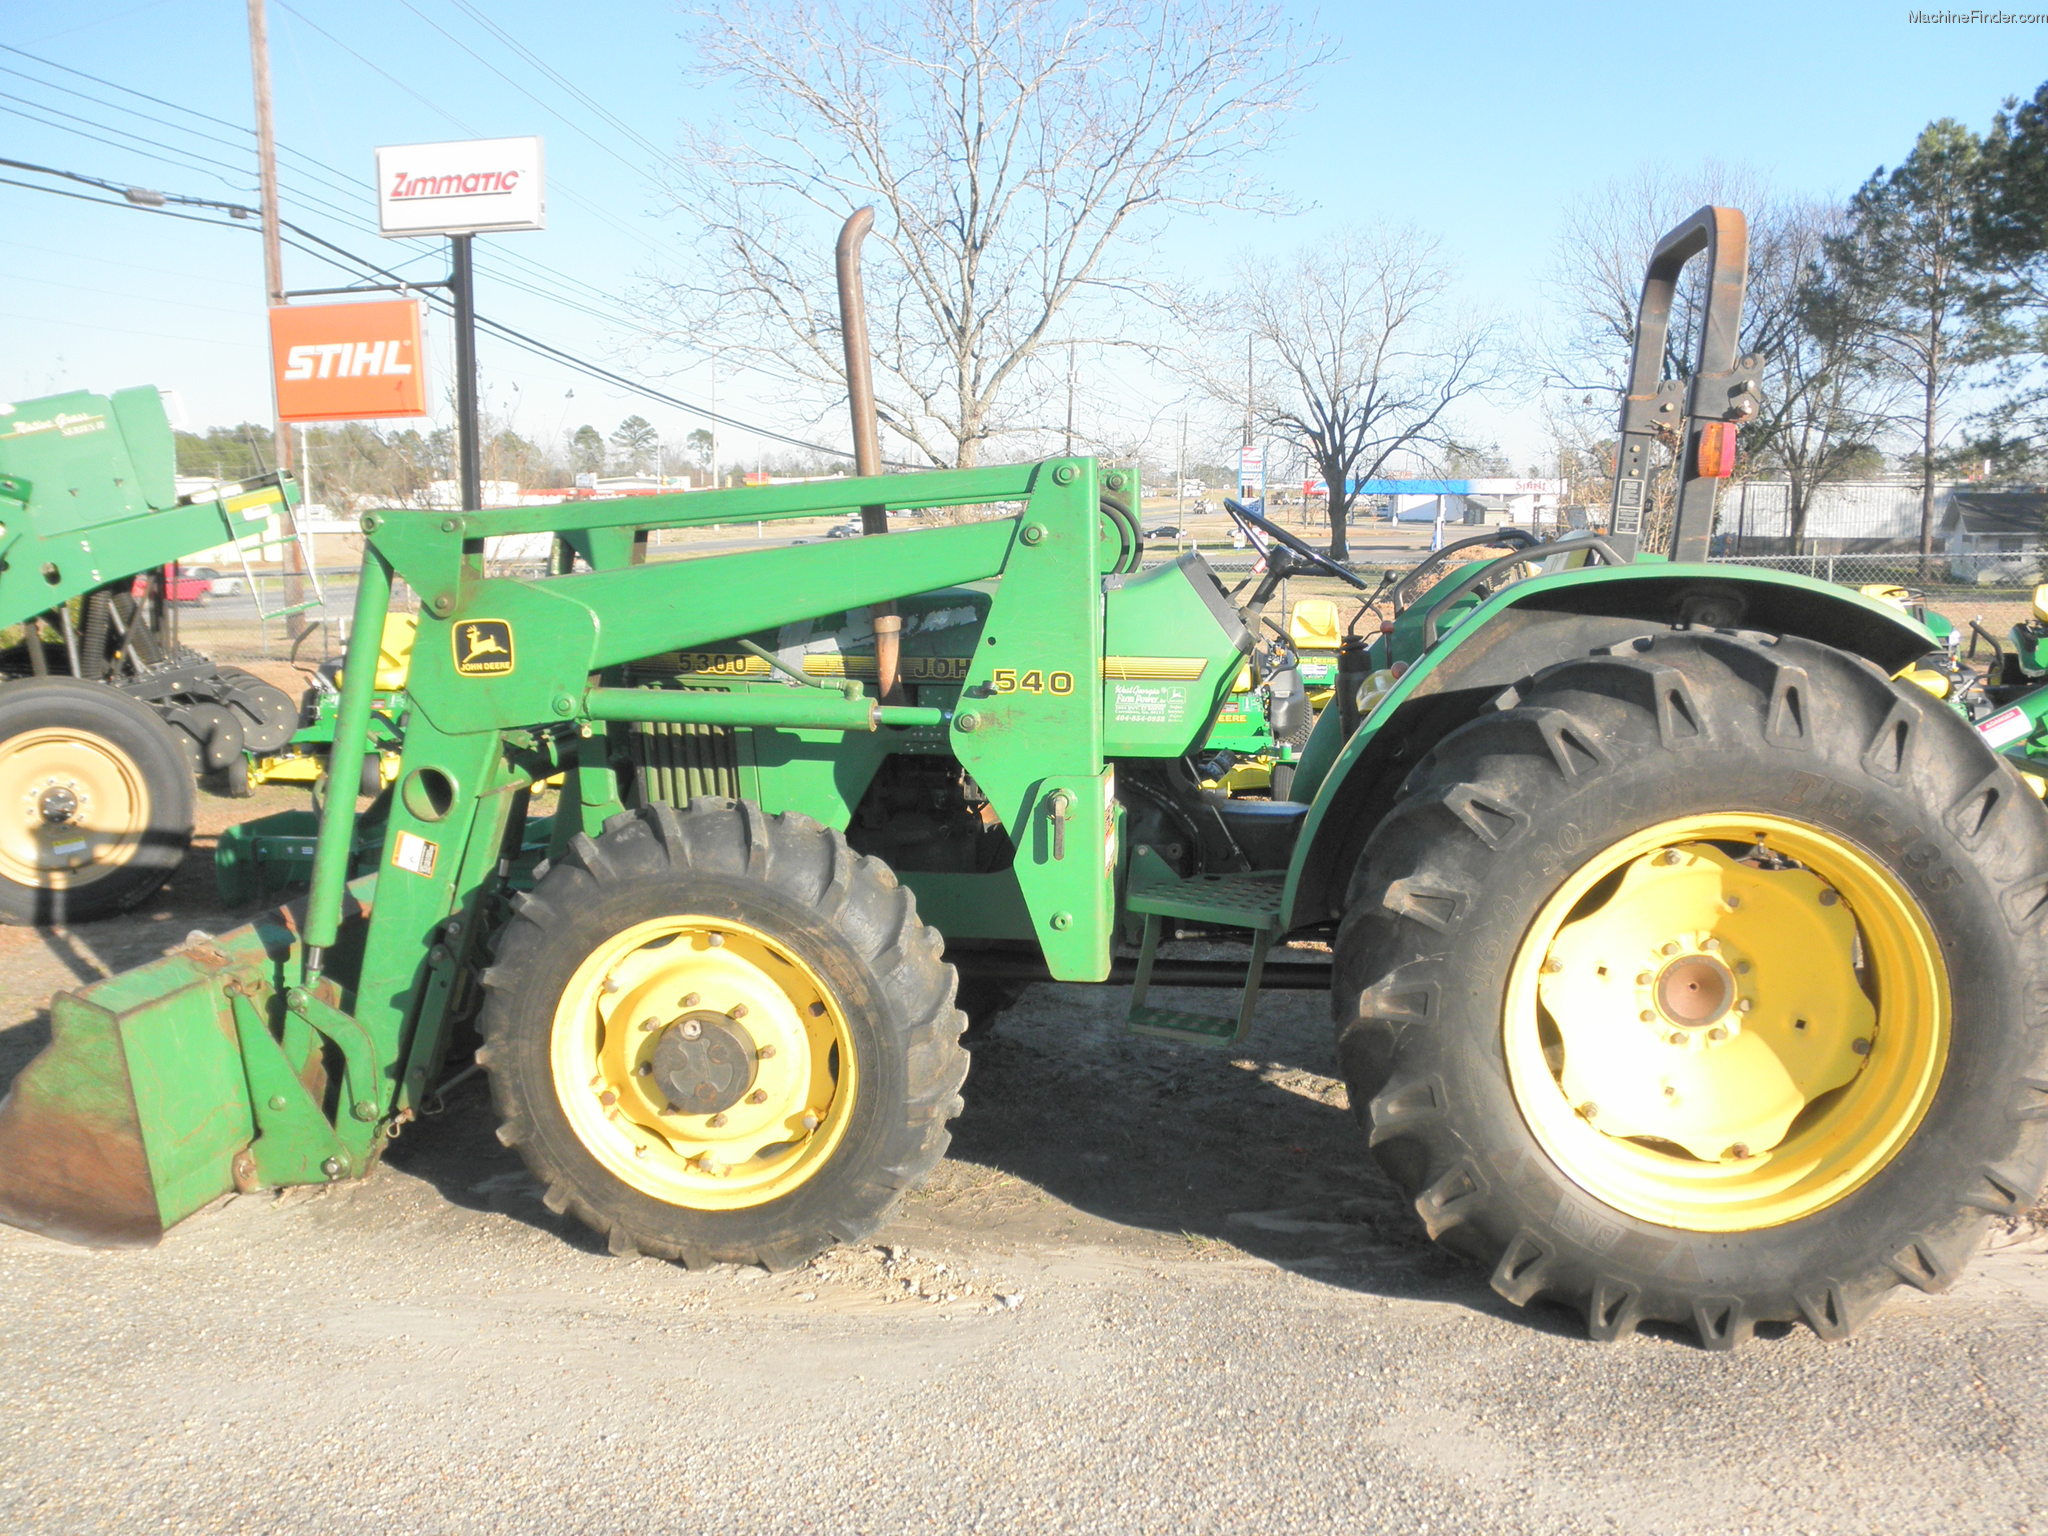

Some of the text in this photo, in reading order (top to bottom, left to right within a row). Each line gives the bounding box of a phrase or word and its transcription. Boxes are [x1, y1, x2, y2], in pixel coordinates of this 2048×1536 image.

[284, 340, 412, 380] STIHL
[460, 661, 510, 672] JOHN DEERE
[678, 653, 749, 675] 5300
[913, 657, 972, 679] JOH
[992, 668, 1075, 697] 540
[1217, 714, 1247, 723] EERE
